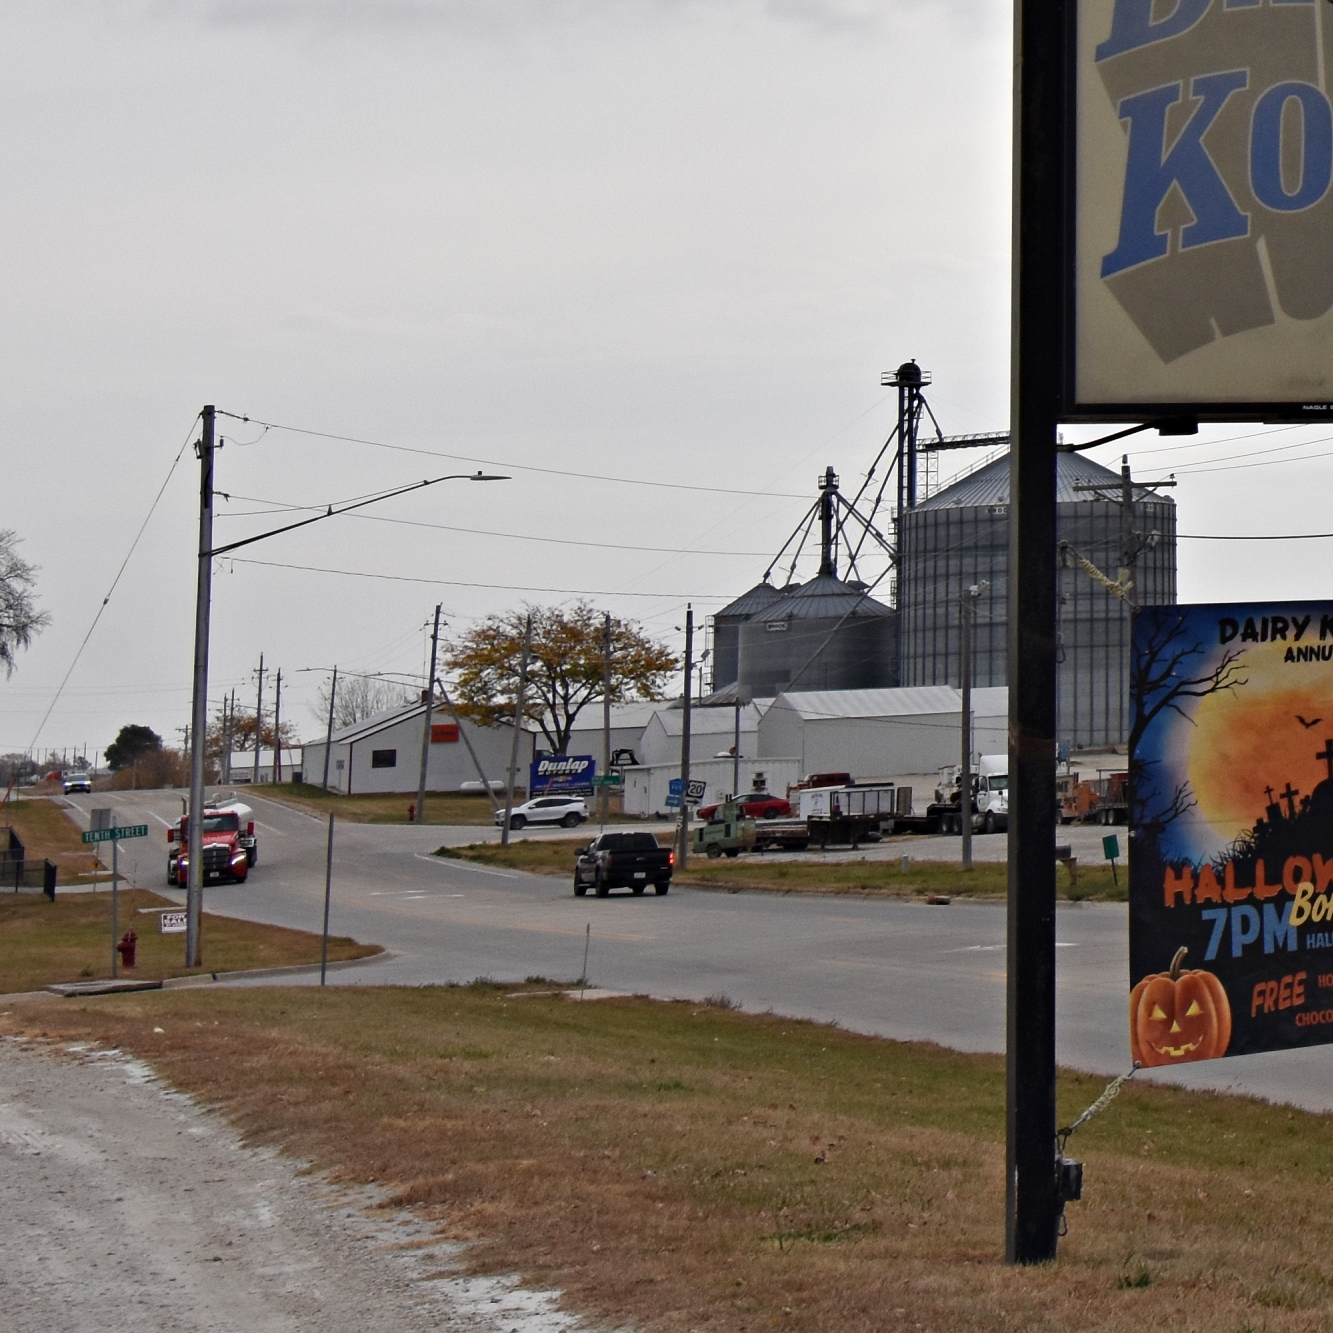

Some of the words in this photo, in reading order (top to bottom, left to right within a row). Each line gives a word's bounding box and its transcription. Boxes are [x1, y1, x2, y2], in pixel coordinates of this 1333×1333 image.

[1218, 616, 1312, 645] DAIRY
[538, 758, 589, 773] Dunlap
[690, 784, 702, 794] 20
[85, 830, 110, 841] TENTH
[115, 826, 146, 838] STREET
[1201, 901, 1298, 962] 7PM
[1251, 970, 1307, 1017] FREE
